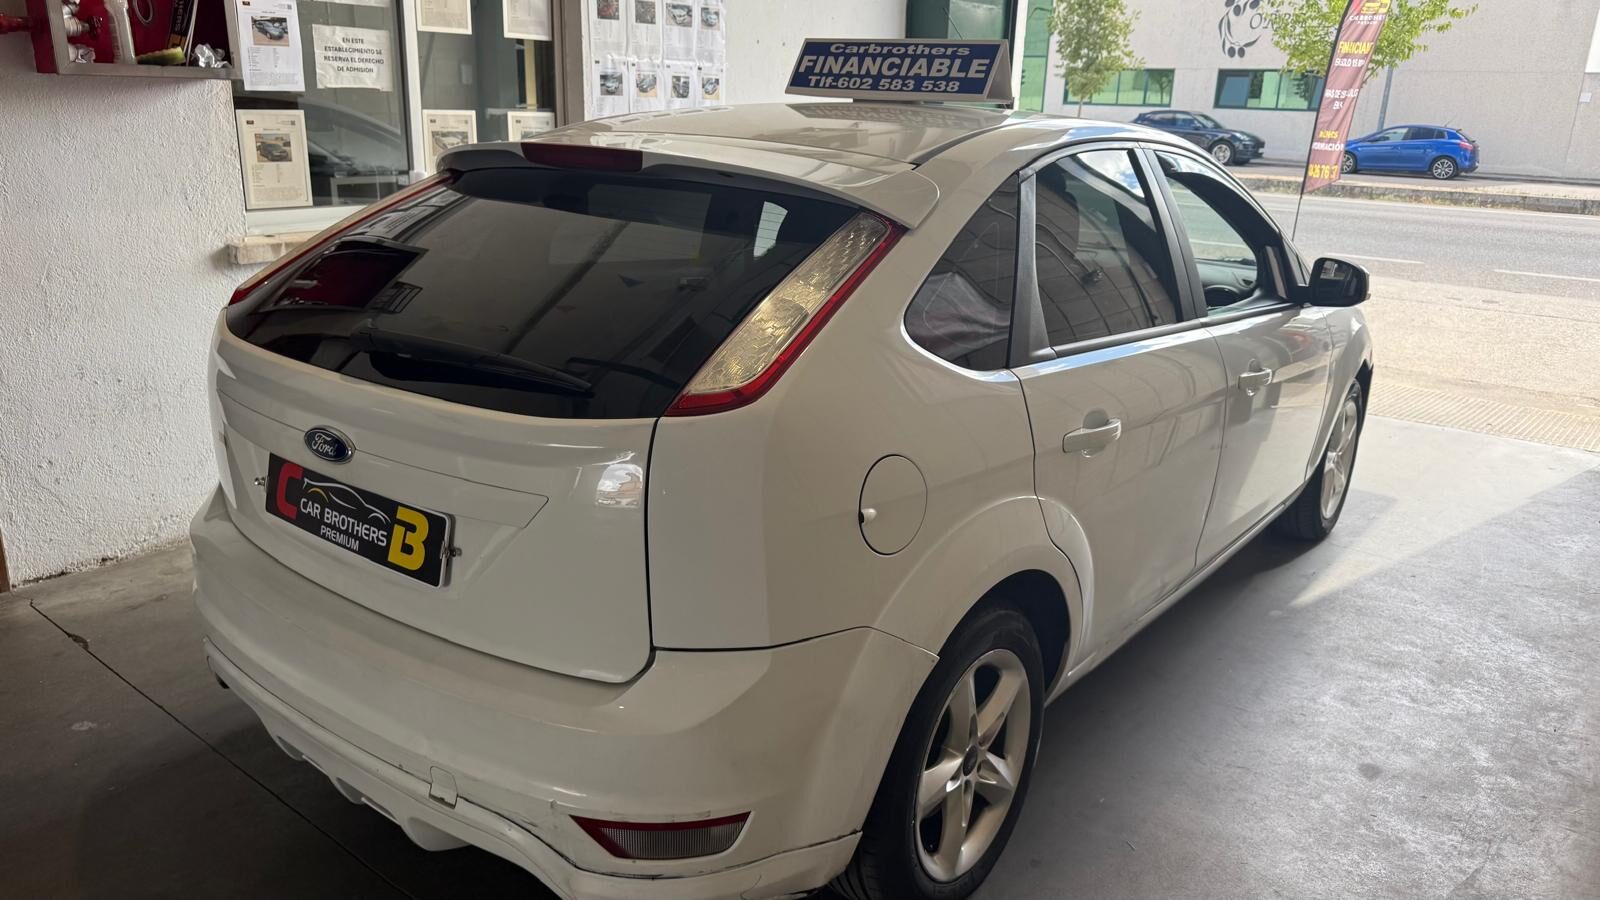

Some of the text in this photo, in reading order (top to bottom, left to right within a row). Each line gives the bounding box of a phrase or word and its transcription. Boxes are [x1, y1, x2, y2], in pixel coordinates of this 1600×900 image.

[324, 46, 375, 54] ESTABLECIMIENTO
[830, 43, 971, 56] Carbrothers
[798, 55, 990, 79] FINANCIABLE
[808, 75, 960, 92] Tlf-602 583 538
[311, 433, 337, 456] Ford
[300, 498, 387, 547] CAR BROTHERS
[320, 525, 359, 551] PREMIUM
